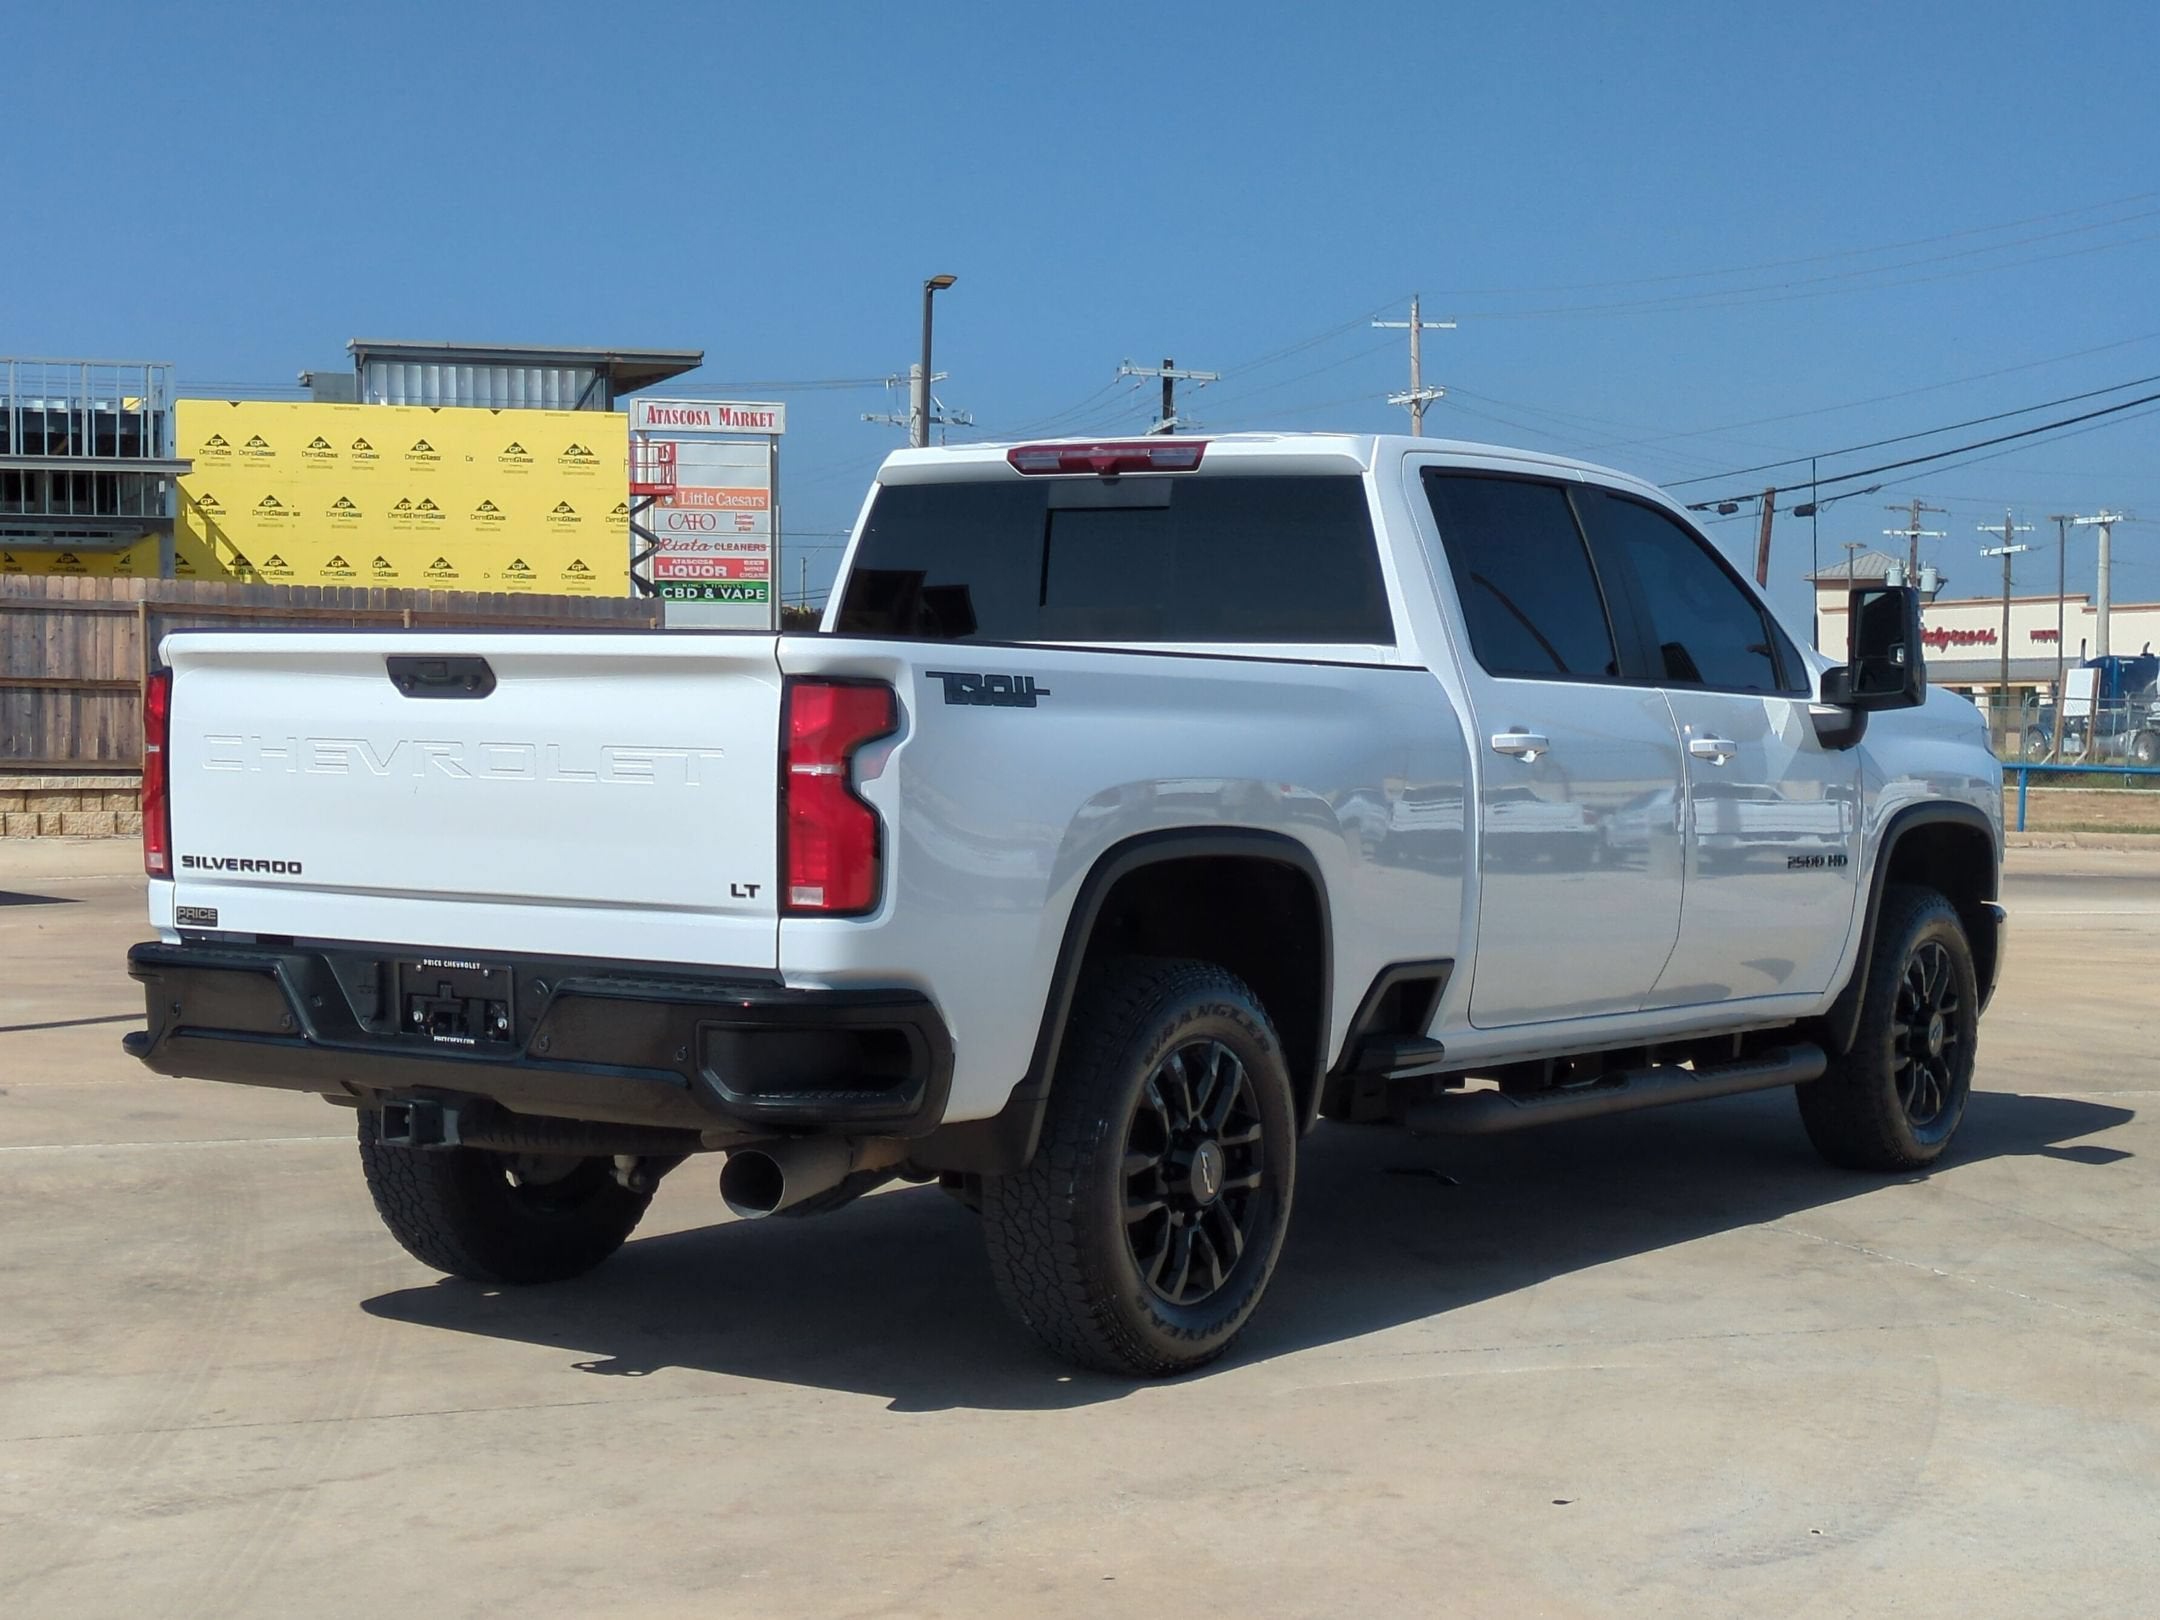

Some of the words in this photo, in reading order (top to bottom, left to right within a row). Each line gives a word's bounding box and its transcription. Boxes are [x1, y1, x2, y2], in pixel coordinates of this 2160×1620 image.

[719, 407, 775, 428] MARKET
[680, 490, 714, 506] Little
[716, 491, 765, 507] Caesars
[667, 512, 717, 531] CATO
[714, 542, 767, 552] CLEANERS
[658, 565, 728, 577] LIQUOR
[662, 587, 698, 599] CBD
[703, 588, 714, 599] &
[720, 588, 766, 600] VAPE
[201, 734, 726, 786] CHEVROLET
[181, 855, 302, 875] SILVERADO
[1787, 855, 1826, 869] 2500
[1827, 854, 1848, 867] HD
[730, 883, 761, 899] LT
[177, 908, 217, 920] PRICE
[423, 958, 442, 967] PRICE
[443, 960, 481, 970] CHEVROLET
